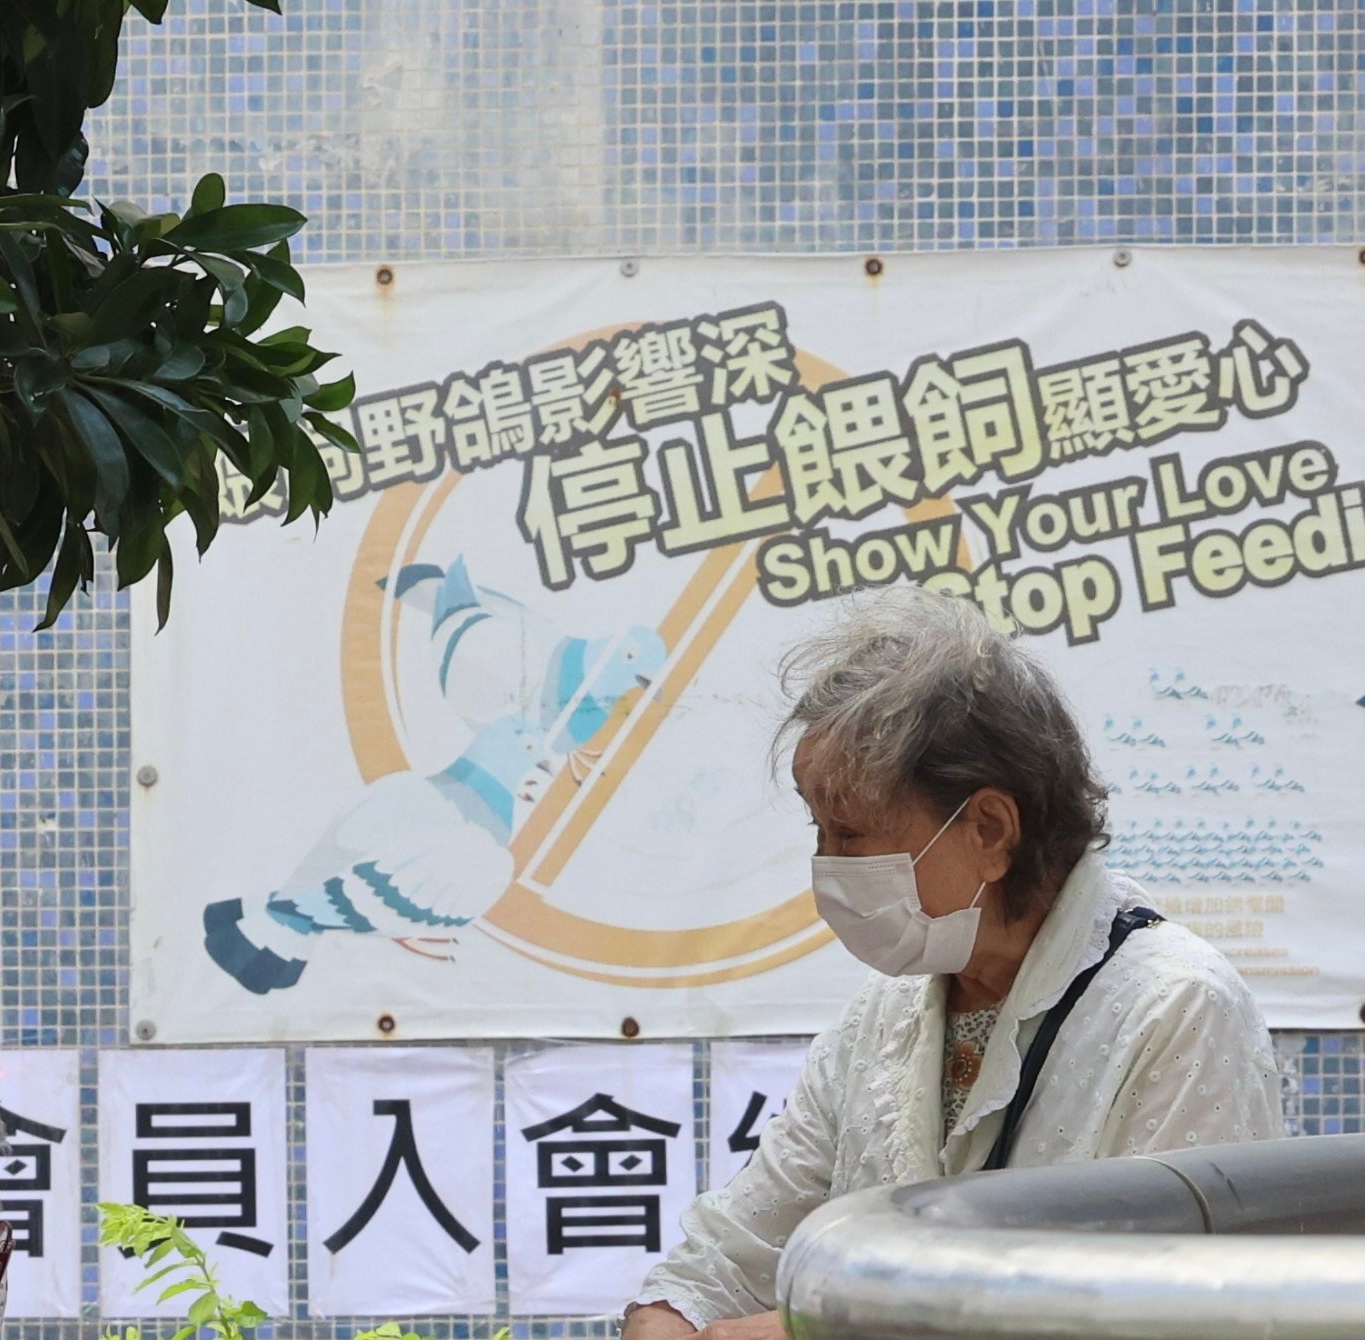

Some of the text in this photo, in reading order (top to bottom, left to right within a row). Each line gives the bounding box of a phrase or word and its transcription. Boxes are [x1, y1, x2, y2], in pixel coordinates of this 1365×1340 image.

[756, 440, 1338, 606] Show Your Love
